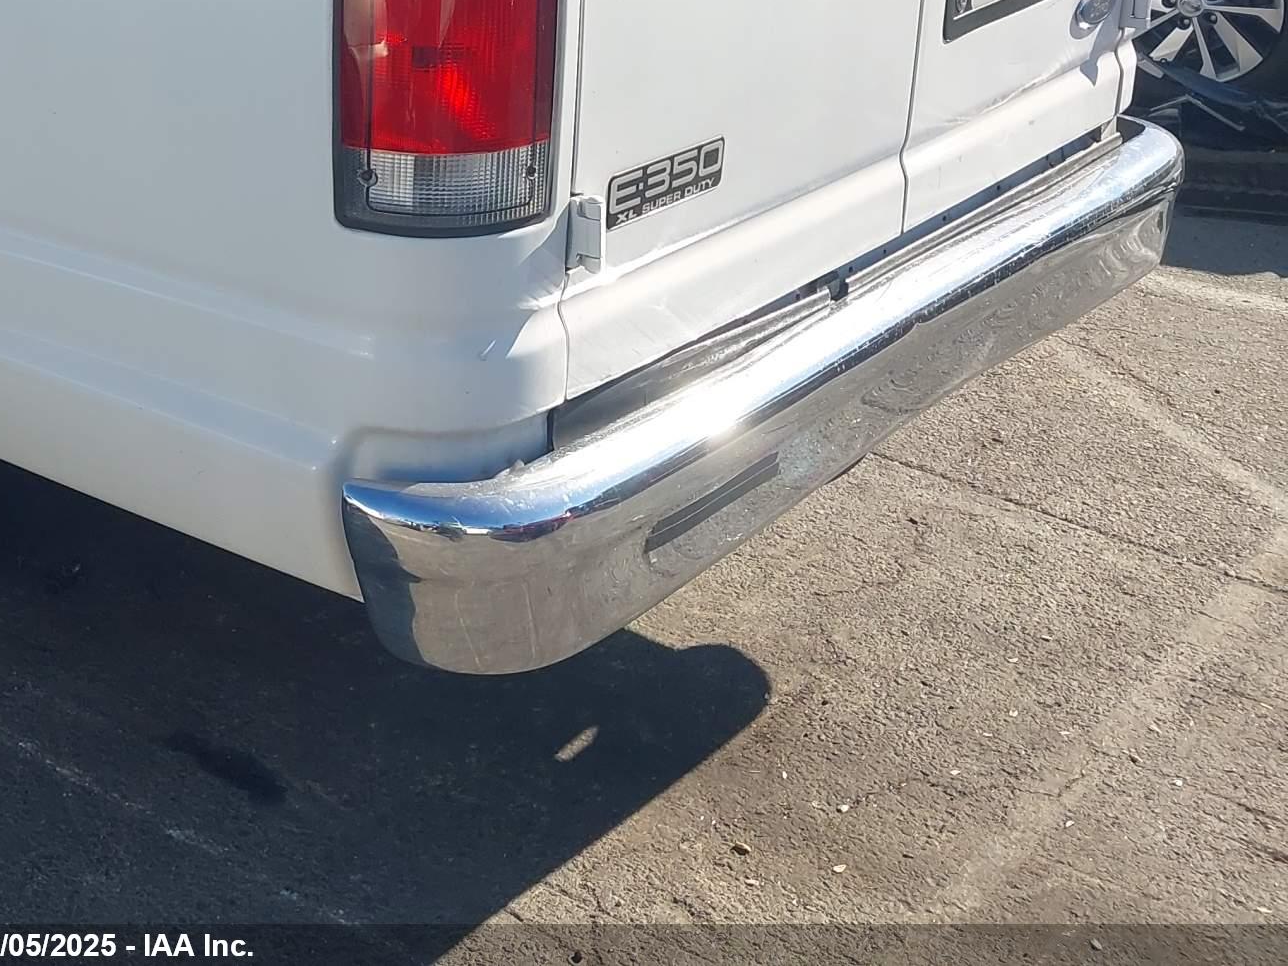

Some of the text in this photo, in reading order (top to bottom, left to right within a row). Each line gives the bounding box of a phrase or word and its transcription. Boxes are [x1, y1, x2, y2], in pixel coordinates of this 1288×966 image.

[616, 177, 716, 224] XL SUPER DUTY
